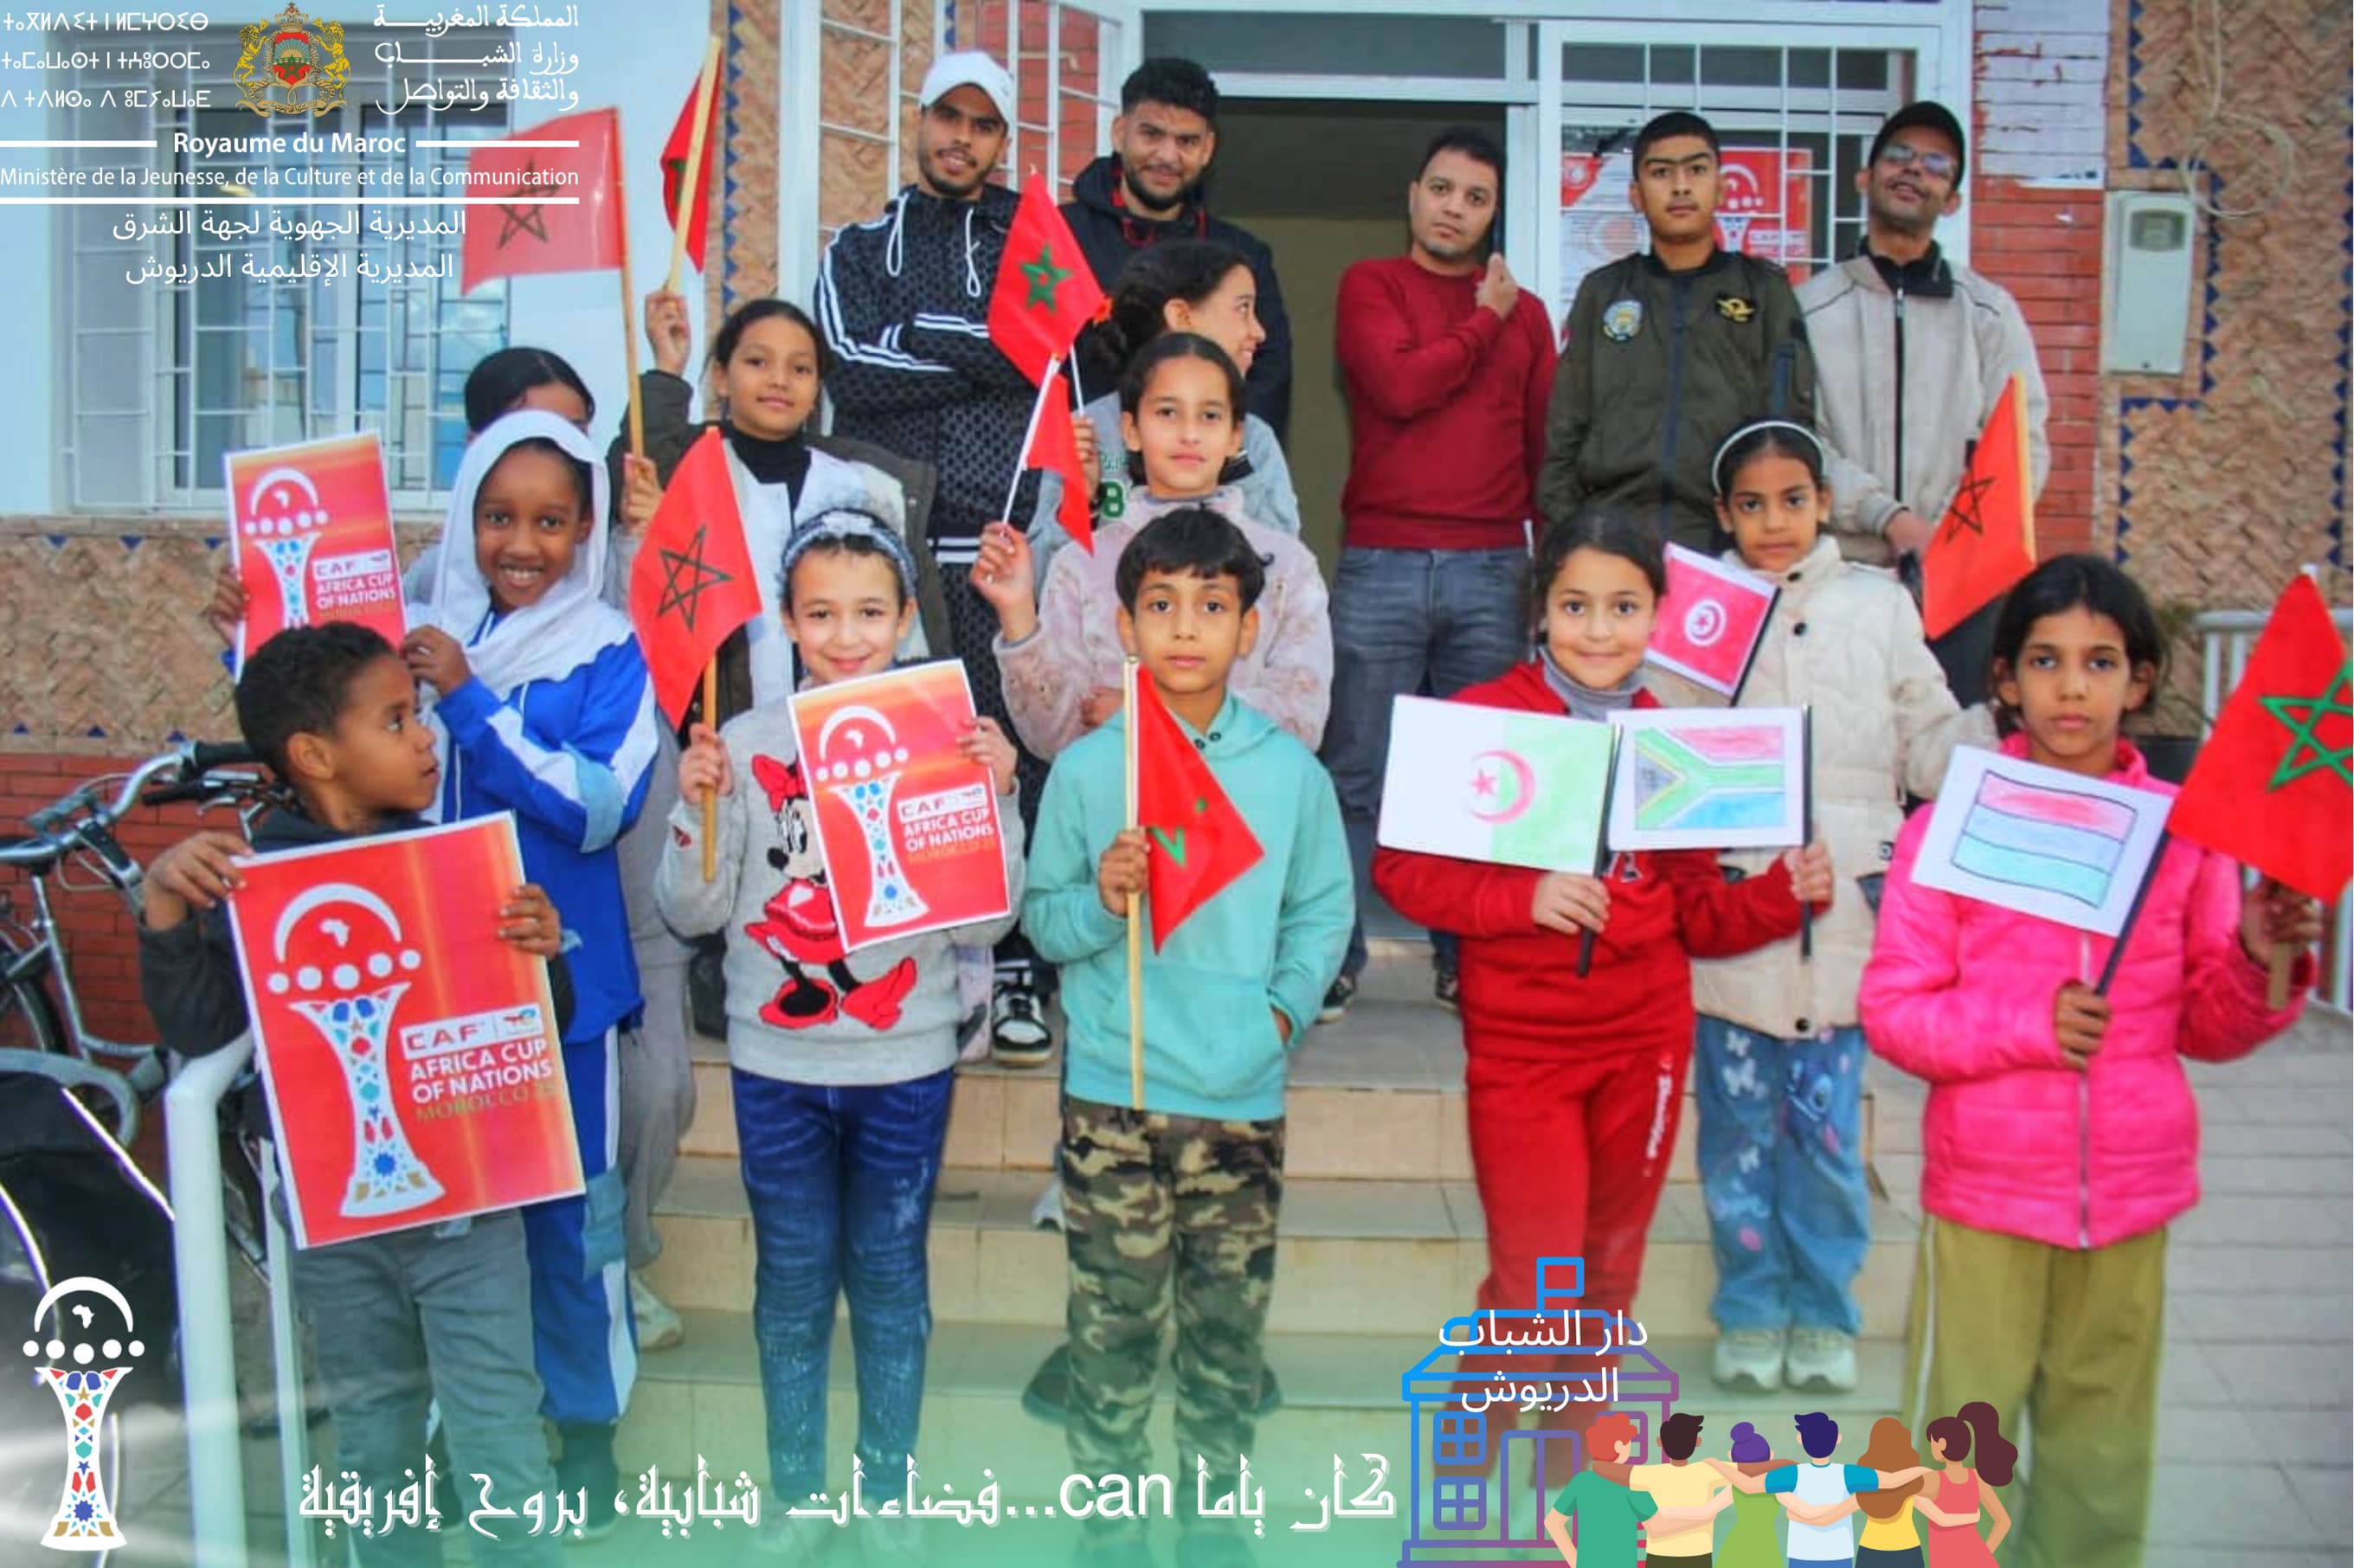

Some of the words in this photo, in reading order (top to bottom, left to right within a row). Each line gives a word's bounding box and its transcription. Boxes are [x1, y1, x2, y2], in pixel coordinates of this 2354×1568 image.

[904, 813, 959, 839] AFRICA
[961, 807, 989, 826] CUP
[905, 834, 925, 852] OF
[929, 824, 994, 846] NATIONS
[406, 1024, 479, 1051] CAF
[411, 1049, 497, 1082] AFRICA
[501, 1038, 548, 1064] CUP
[412, 1079, 445, 1104] OF
[449, 1058, 553, 1096] NATIONS
